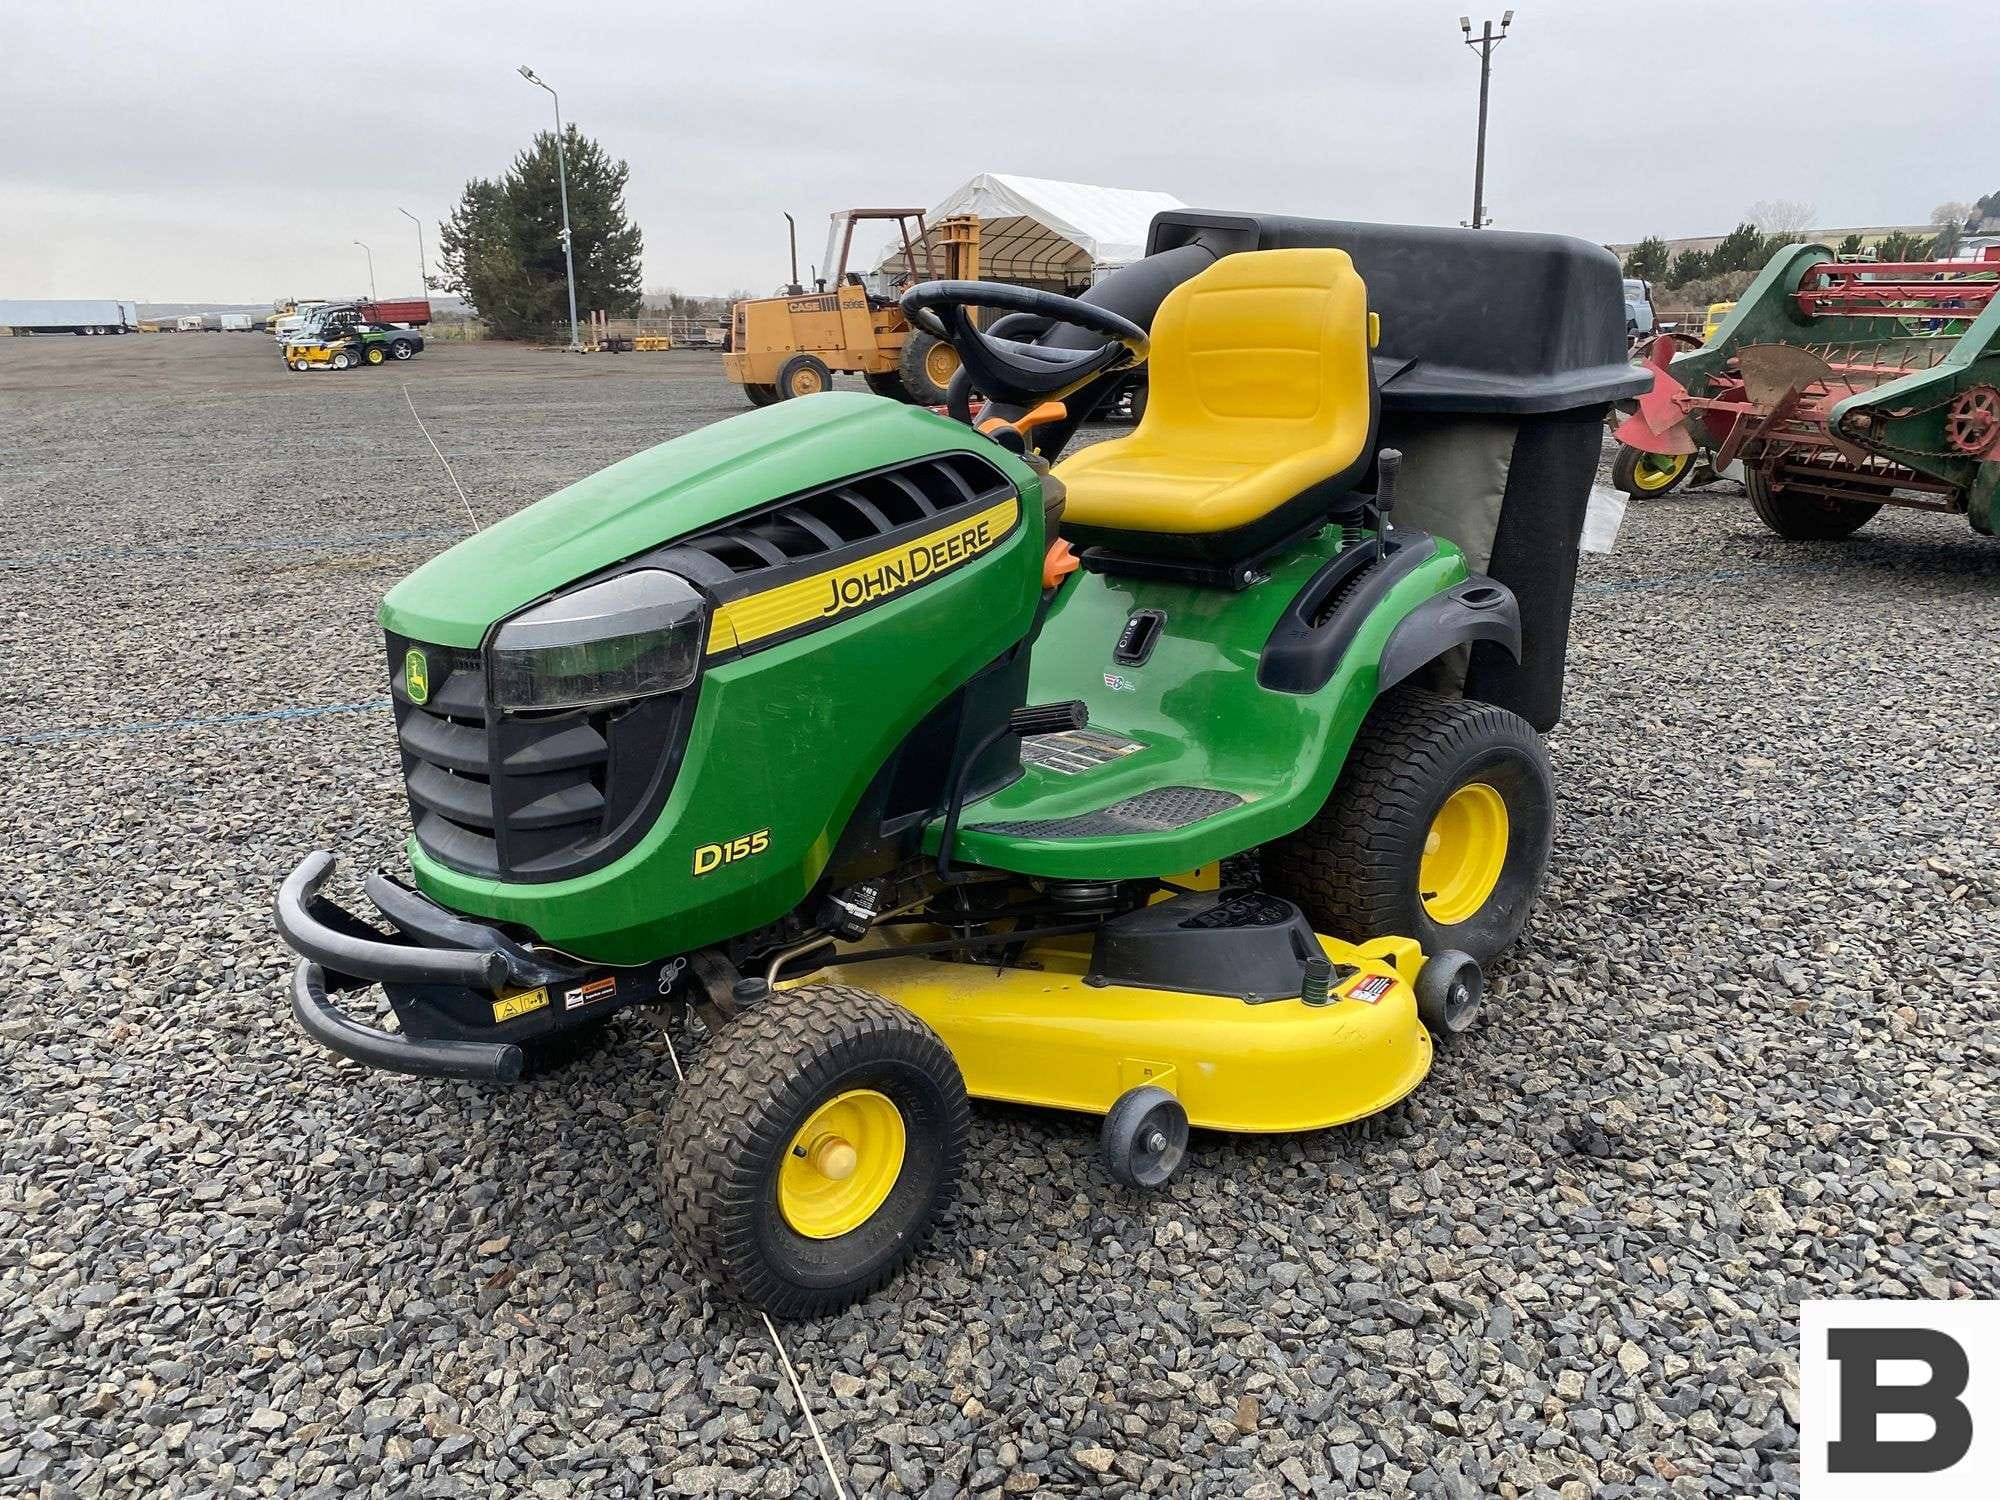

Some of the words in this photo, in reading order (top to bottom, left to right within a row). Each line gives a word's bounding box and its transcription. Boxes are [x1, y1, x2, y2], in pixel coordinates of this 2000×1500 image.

[789, 302, 820, 313] CASE
[823, 560, 904, 614] JOHN
[909, 520, 991, 579] DEERE
[693, 829, 769, 876] D155
